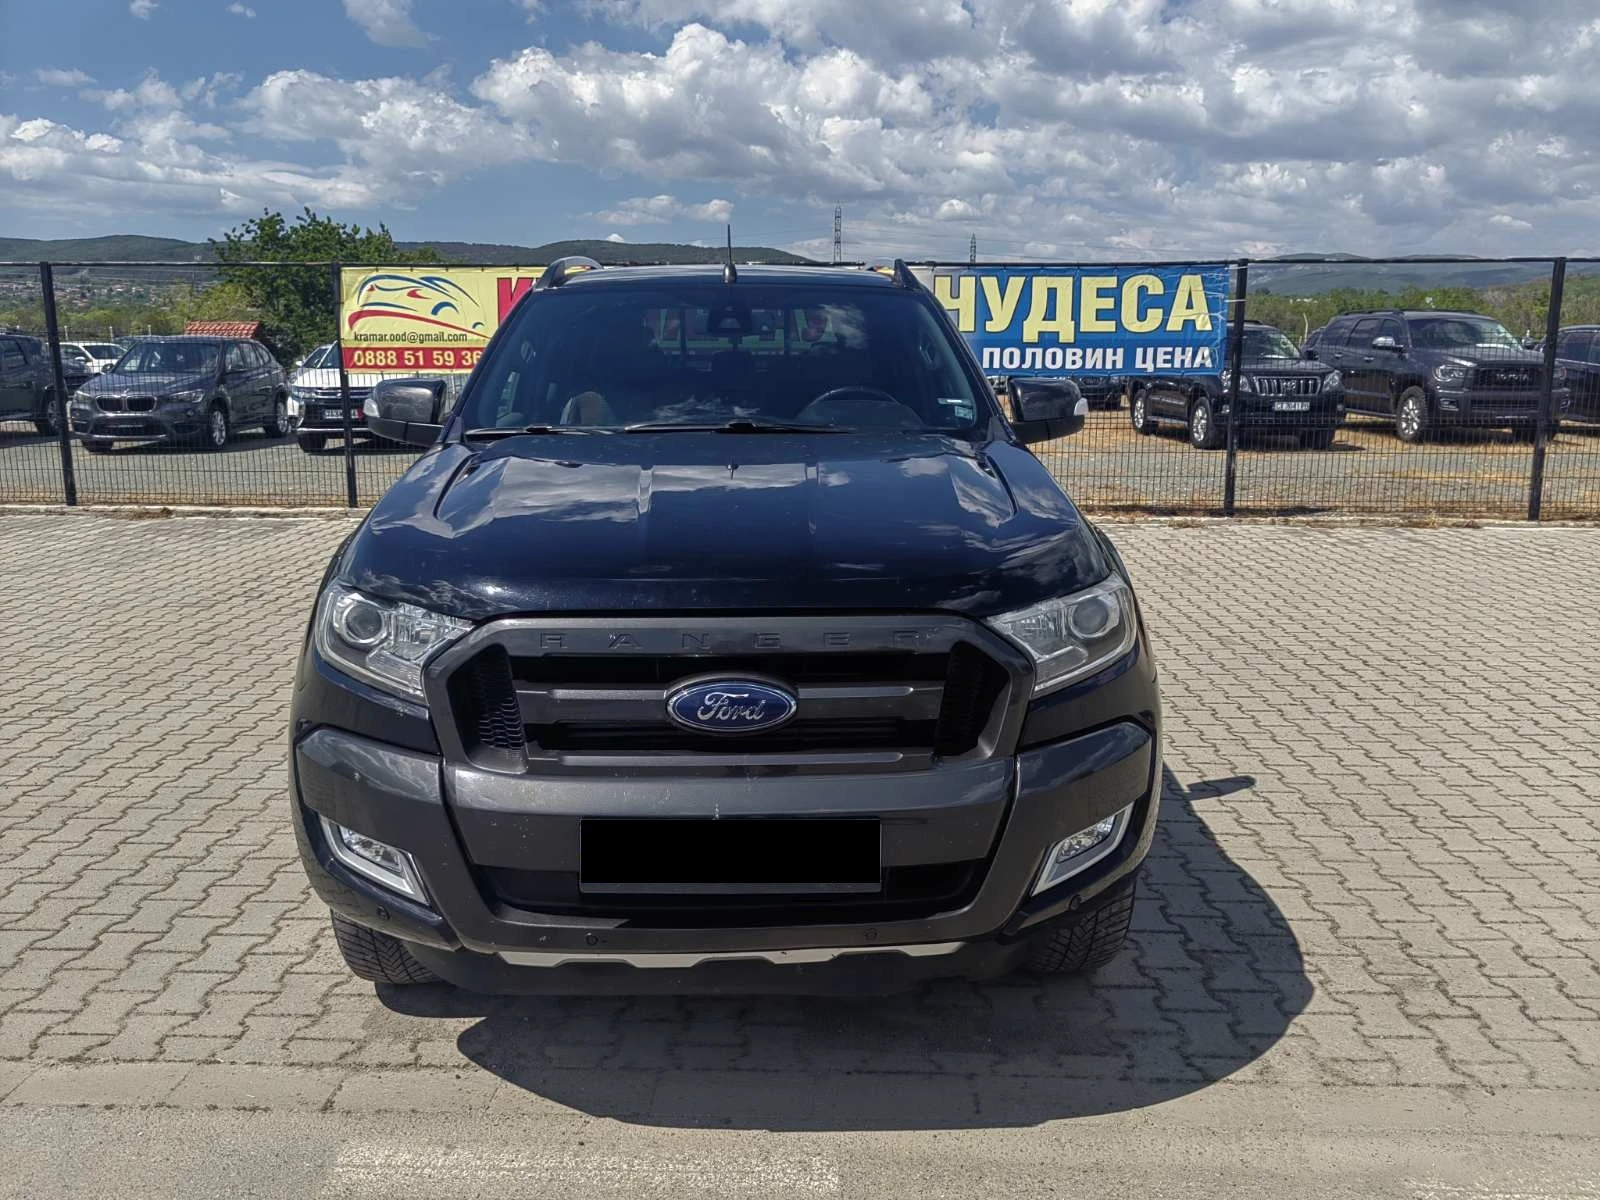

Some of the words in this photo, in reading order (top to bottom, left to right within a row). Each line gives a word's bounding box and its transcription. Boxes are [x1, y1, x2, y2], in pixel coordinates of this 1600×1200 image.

[933, 273, 1213, 344] ЧУДЕСА
[353, 331, 468, 344] kramar.ood@gmail.com
[353, 350, 397, 366] 0888
[404, 350, 425, 366] 51
[432, 350, 455, 366] 59
[461, 350, 482, 366] 36
[982, 347, 1124, 370] ПОЛОВИН
[1135, 346, 1214, 373] ЦЕНА
[539, 631, 921, 650] RANGER
[697, 690, 766, 721] Ford
